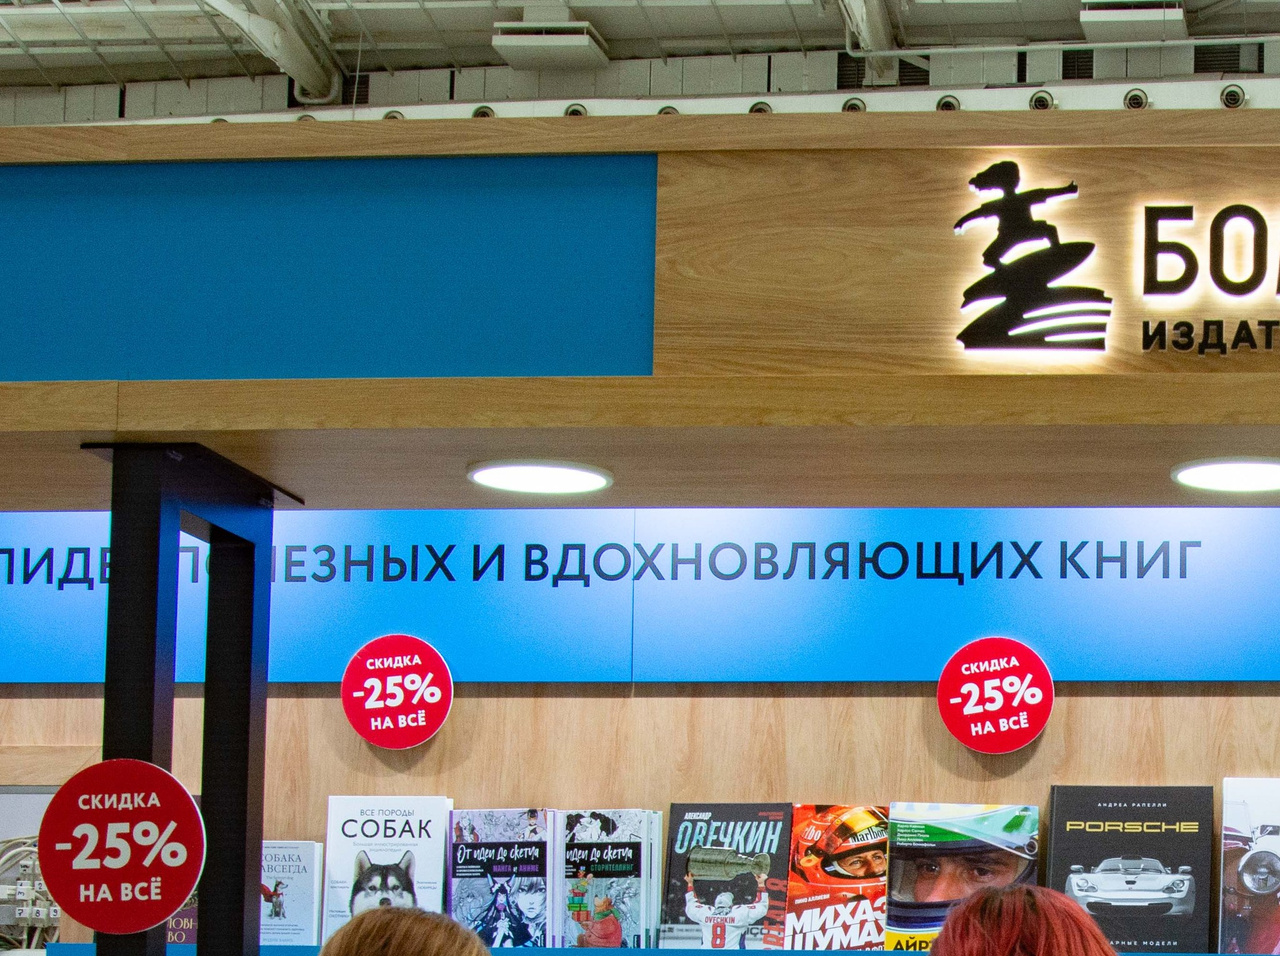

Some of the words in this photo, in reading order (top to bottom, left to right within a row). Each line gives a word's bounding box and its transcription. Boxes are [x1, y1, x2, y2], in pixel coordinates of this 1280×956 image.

[179, 543, 456, 584] ПЕЗНЫХ
[473, 543, 506, 583] И
[524, 541, 1043, 588] ВДОХНОВЛЯЮЩИХ
[1060, 541, 1202, 580] КНИГ
[365, 654, 422, 669] СКИДКА
[961, 656, 1020, 675] СКИДКА
[353, 672, 442, 710] -25%
[949, 673, 1043, 716] -25%
[370, 716, 394, 731] НА
[398, 709, 427, 728] ВСЁ
[970, 721, 996, 736] НА
[998, 711, 1030, 732] ВСЁ
[78, 792, 160, 810] СКИДКА
[378, 809, 414, 817] ПОРОДЫ
[684, 812, 712, 820] АЛЕКСАНДР
[342, 819, 432, 838] СОБАК
[1066, 821, 1199, 833] PORSCHE
[55, 820, 187, 870] -25%
[675, 821, 783, 854] ОВЕЧКИН
[457, 846, 472, 864] От
[497, 849, 507, 862] до
[590, 849, 600, 861] до
[262, 864, 307, 874] АВСЕГДА
[591, 864, 634, 872] СТОРИТЕЛЛИНГ
[80, 884, 113, 902] НА
[120, 877, 162, 901] ВСЁ
[705, 916, 736, 924] OVECHKIN
[711, 923, 727, 948] 8
[893, 936, 933, 951] АЙР
